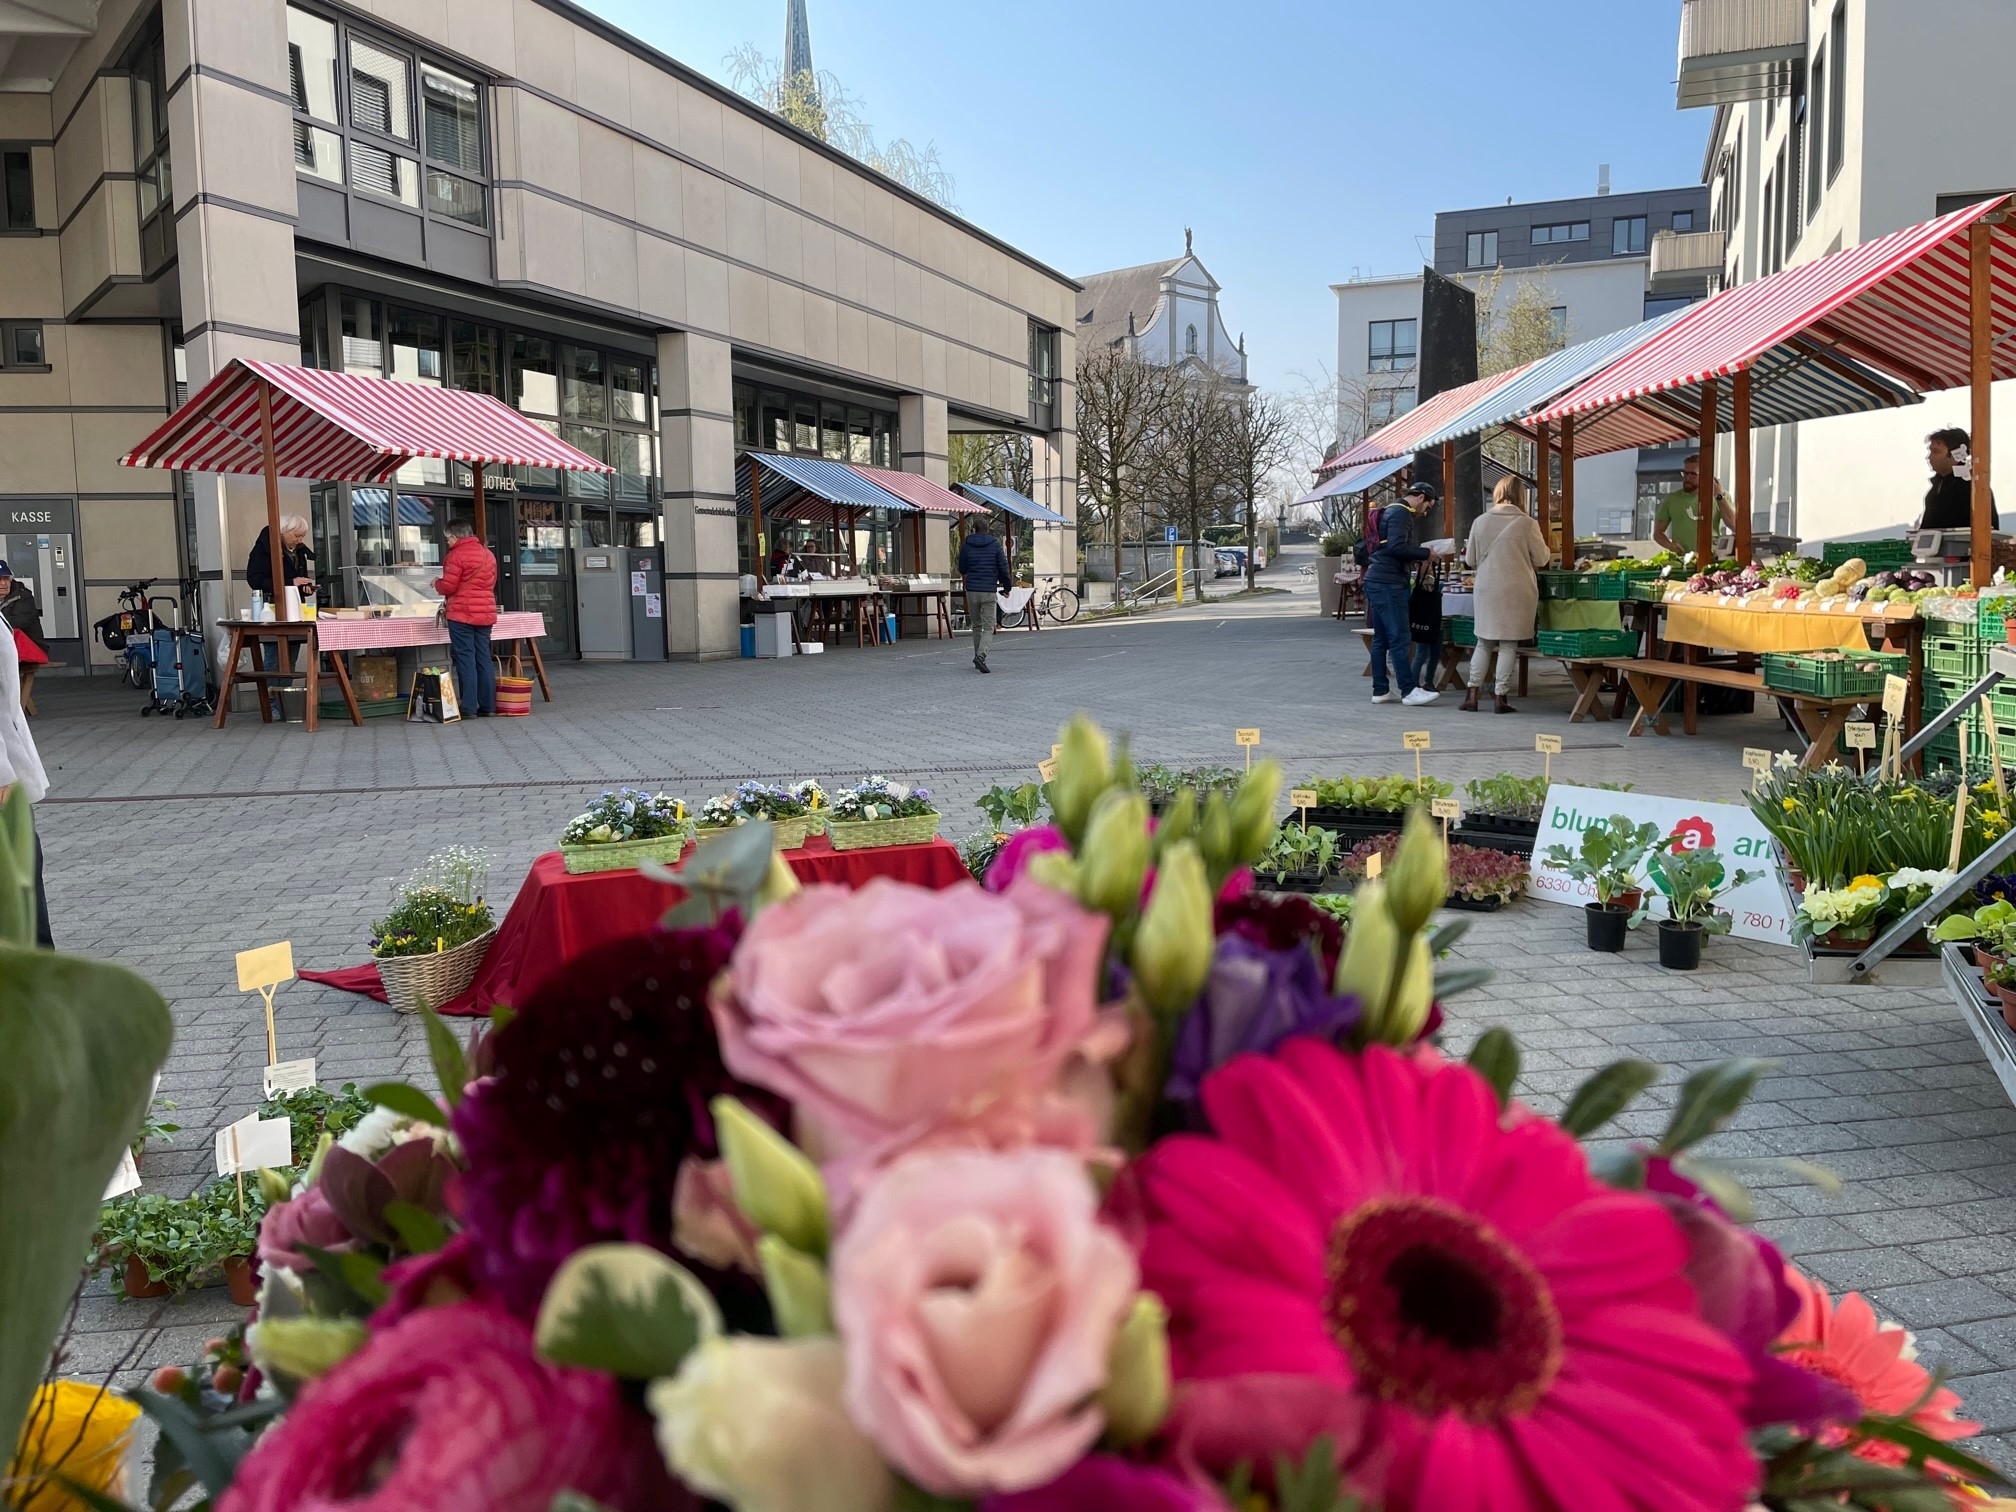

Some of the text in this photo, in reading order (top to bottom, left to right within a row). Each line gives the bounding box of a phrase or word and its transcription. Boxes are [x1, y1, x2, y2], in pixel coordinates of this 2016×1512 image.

[464, 473, 520, 493] BIIOTHEK,
[11, 511, 52, 523] KASSE
[1411, 622, 1430, 631] zero
[1551, 806, 1614, 833] blum
[1536, 875, 1572, 893] 6330
[1743, 911, 1773, 929] 780
